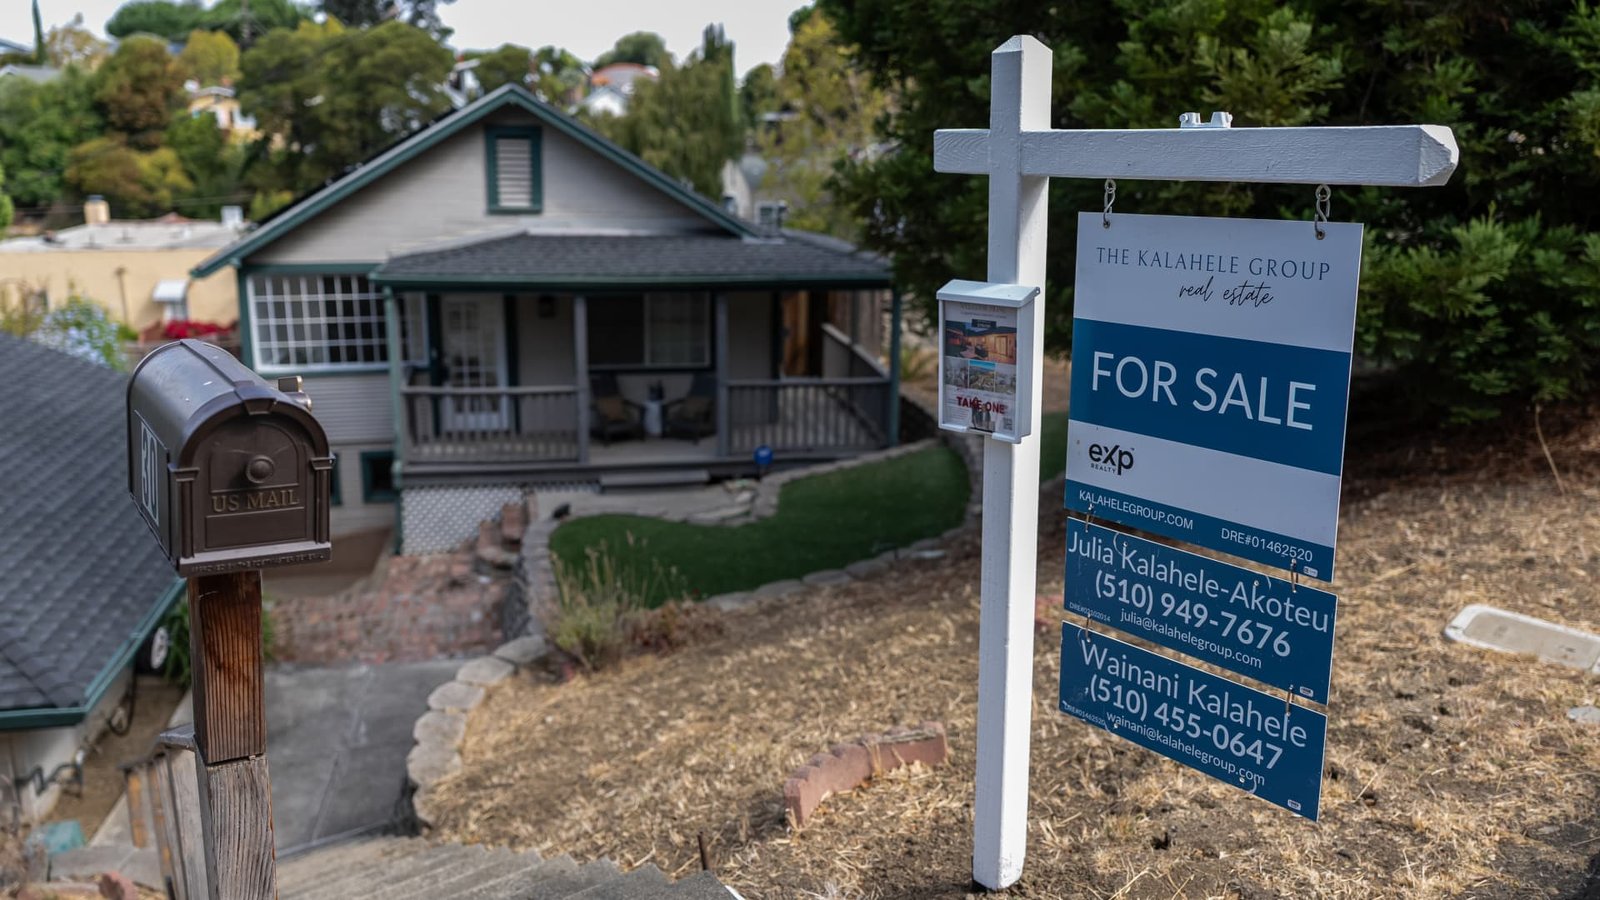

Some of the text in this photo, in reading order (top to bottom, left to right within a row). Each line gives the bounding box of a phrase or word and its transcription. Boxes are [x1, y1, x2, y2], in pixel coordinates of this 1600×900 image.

[1096, 247, 1330, 281] THE KALAHELE GROUP
[1179, 276, 1274, 308] real estate
[956, 396, 982, 411] TAKE
[985, 401, 1006, 415] ONE
[1092, 351, 1316, 430] FOR SALE
[141, 421, 159, 526] 30
[1090, 462, 1116, 474] REALTY
[212, 489, 299, 512] US MAIL
[1079, 490, 1193, 530] KALAHELEGROUP.COM
[1221, 528, 1313, 562] DRE#01462520
[1068, 531, 1329, 633] Julia Kalahele-Akoteu
[1095, 570, 1291, 657] (510) 949-7676
[1120, 608, 1262, 669] julia@kalahelegroup.com
[1081, 640, 1307, 748] Wainani Kalahele
[1090, 674, 1283, 769] (510) 455-0647
[1106, 711, 1265, 786] wainani@kalahelegroup.com
